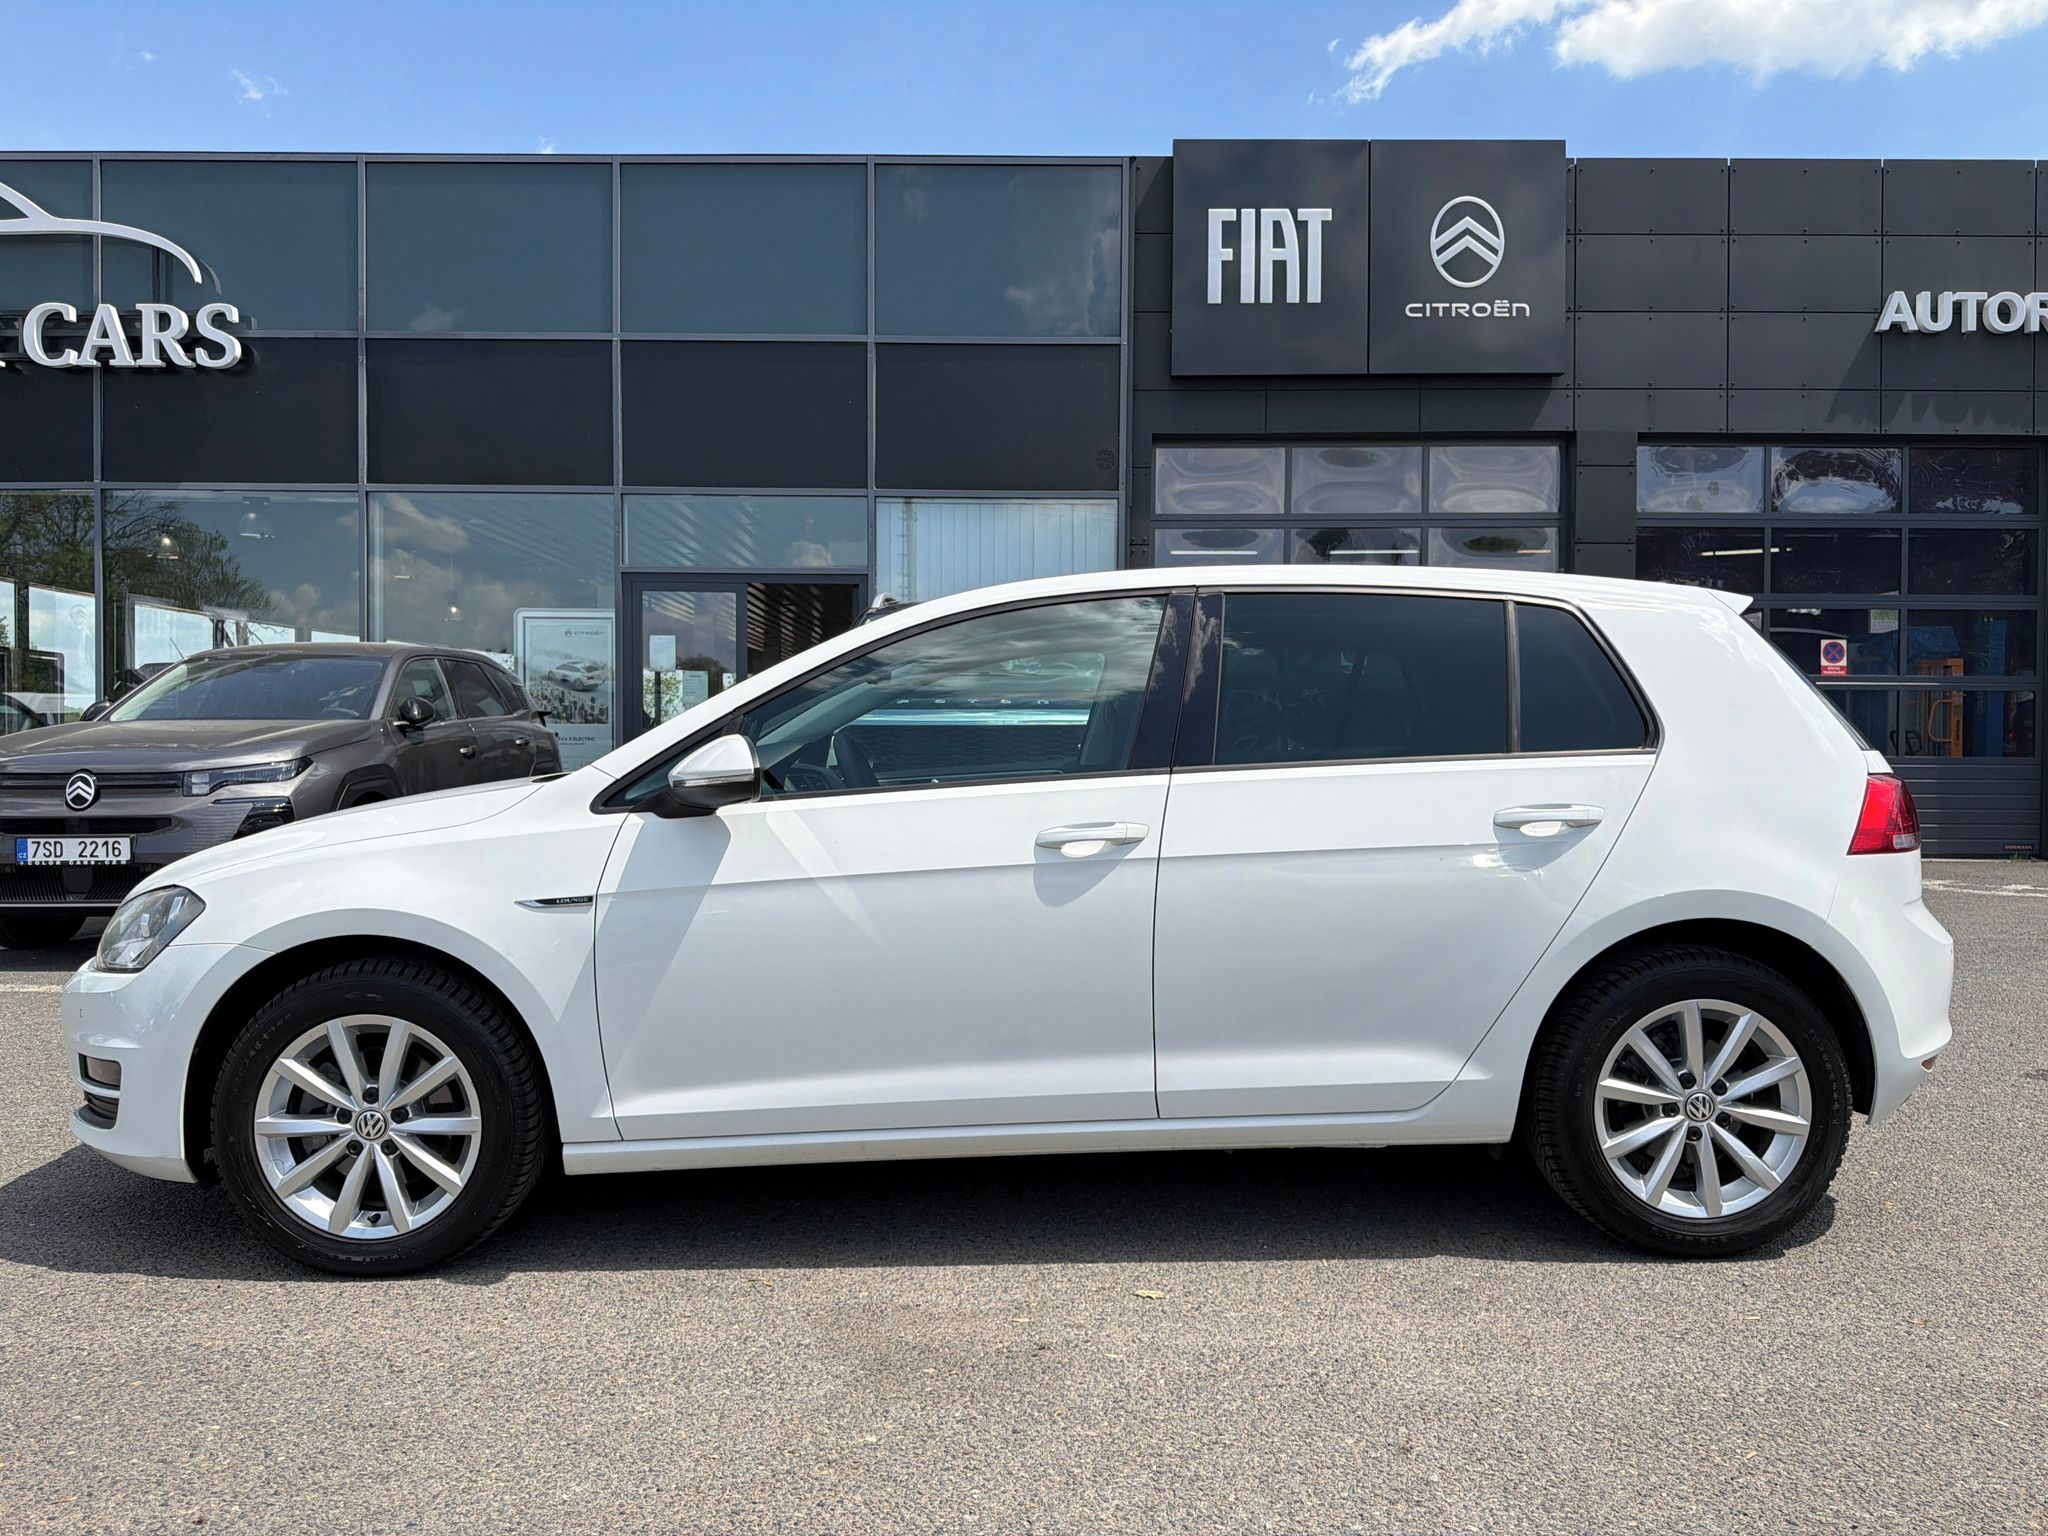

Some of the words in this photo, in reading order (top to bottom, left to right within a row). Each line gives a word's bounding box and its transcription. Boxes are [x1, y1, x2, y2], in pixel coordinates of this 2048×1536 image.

[1207, 208, 1333, 304] FIAT
[1404, 300, 1531, 318] CITROËN
[23, 302, 242, 369] CARS
[31, 841, 64, 859] 7SD
[78, 840, 122, 859] 2216
